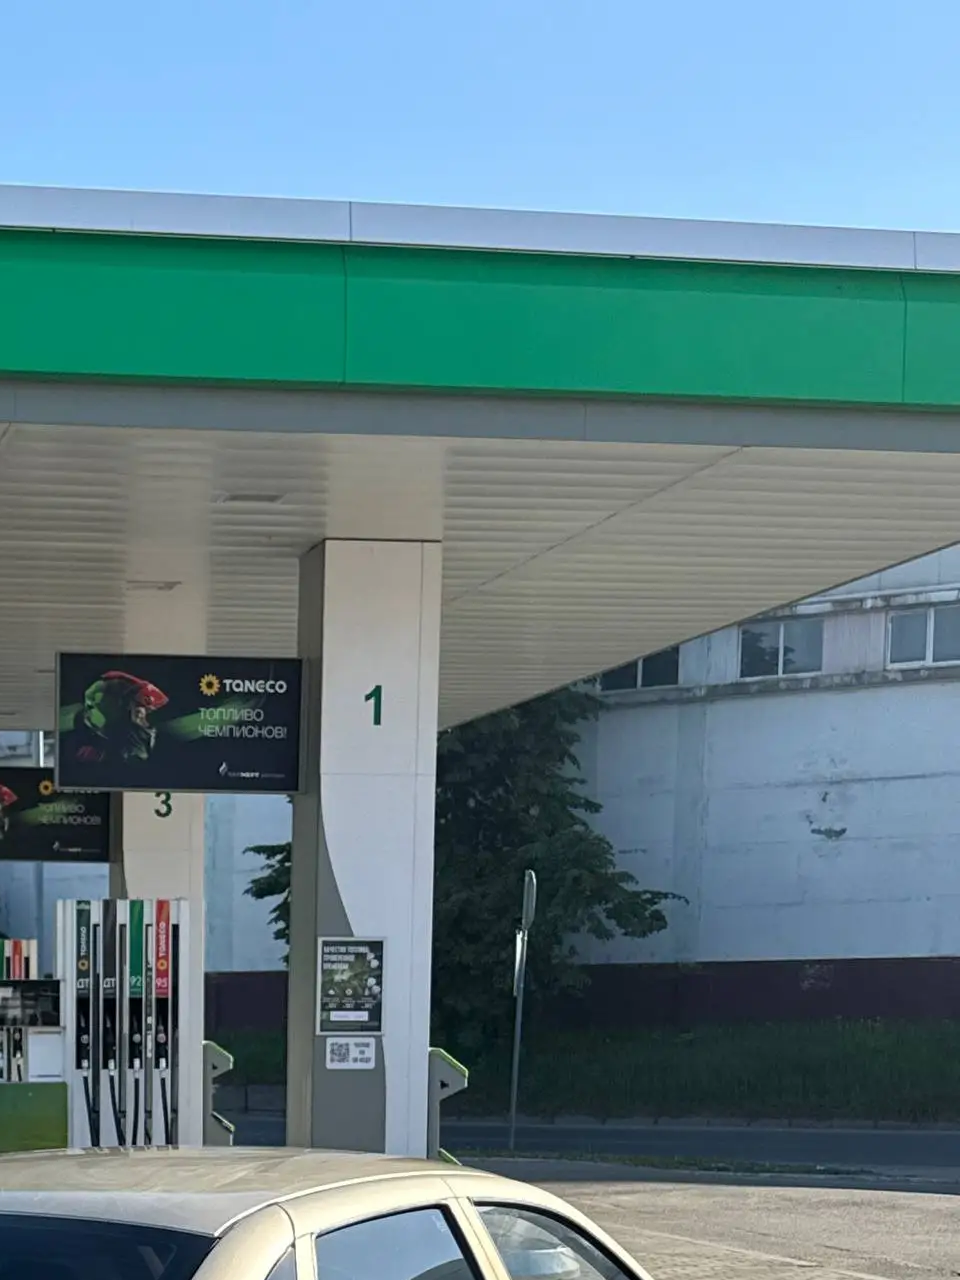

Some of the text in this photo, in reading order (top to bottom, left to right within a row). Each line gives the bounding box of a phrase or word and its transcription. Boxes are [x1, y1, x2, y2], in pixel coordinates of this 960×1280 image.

[364, 684, 382, 726] 1
[199, 707, 264, 722] ТОПЛИВО
[198, 724, 287, 739] ЧЕМПИОНОВ!
[154, 790, 172, 818] 3
[130, 975, 143, 987] 92
[156, 977, 168, 988] 95
